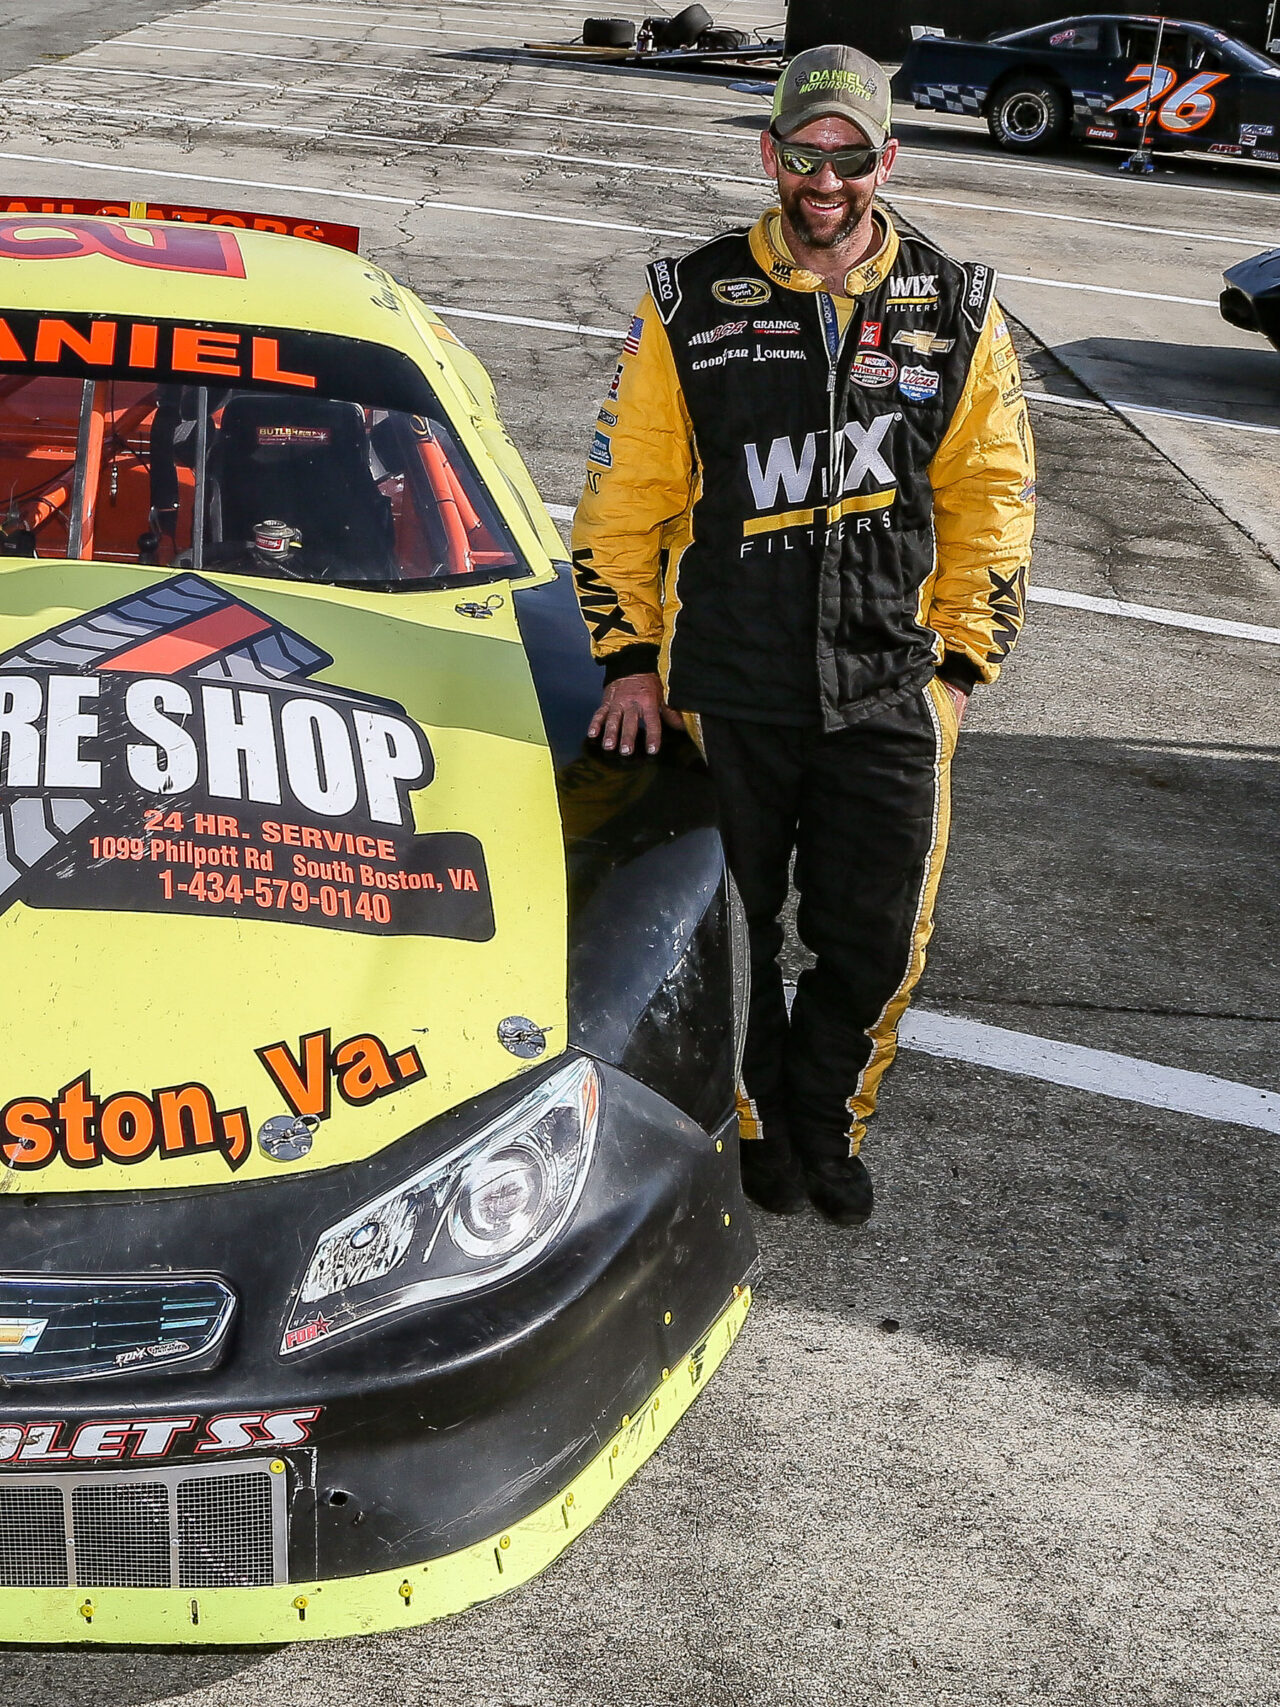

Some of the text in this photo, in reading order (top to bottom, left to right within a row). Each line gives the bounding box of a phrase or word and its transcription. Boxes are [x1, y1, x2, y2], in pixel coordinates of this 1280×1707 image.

[799, 80, 872, 101] MOTORSPORTS
[809, 69, 864, 89] DANIEL
[1106, 64, 1230, 133] 26
[731, 289, 752, 298] Sprint
[886, 303, 938, 314] FILTERS
[889, 274, 940, 297] WIX
[851, 364, 891, 377] WHELEN
[903, 374, 937, 387] LUCAS
[744, 412, 898, 510] WIX
[572, 548, 638, 642] WIX
[125, 678, 425, 824] SHOP
[143, 809, 397, 862] 24 HR. SERVICE
[89, 836, 479, 893] 1099 Philpott Rd South Boston, VA
[159, 869, 393, 924] 1-434-579-0140
[256, 1026, 426, 1120] Va.
[195, 1407, 322, 1455] SS
